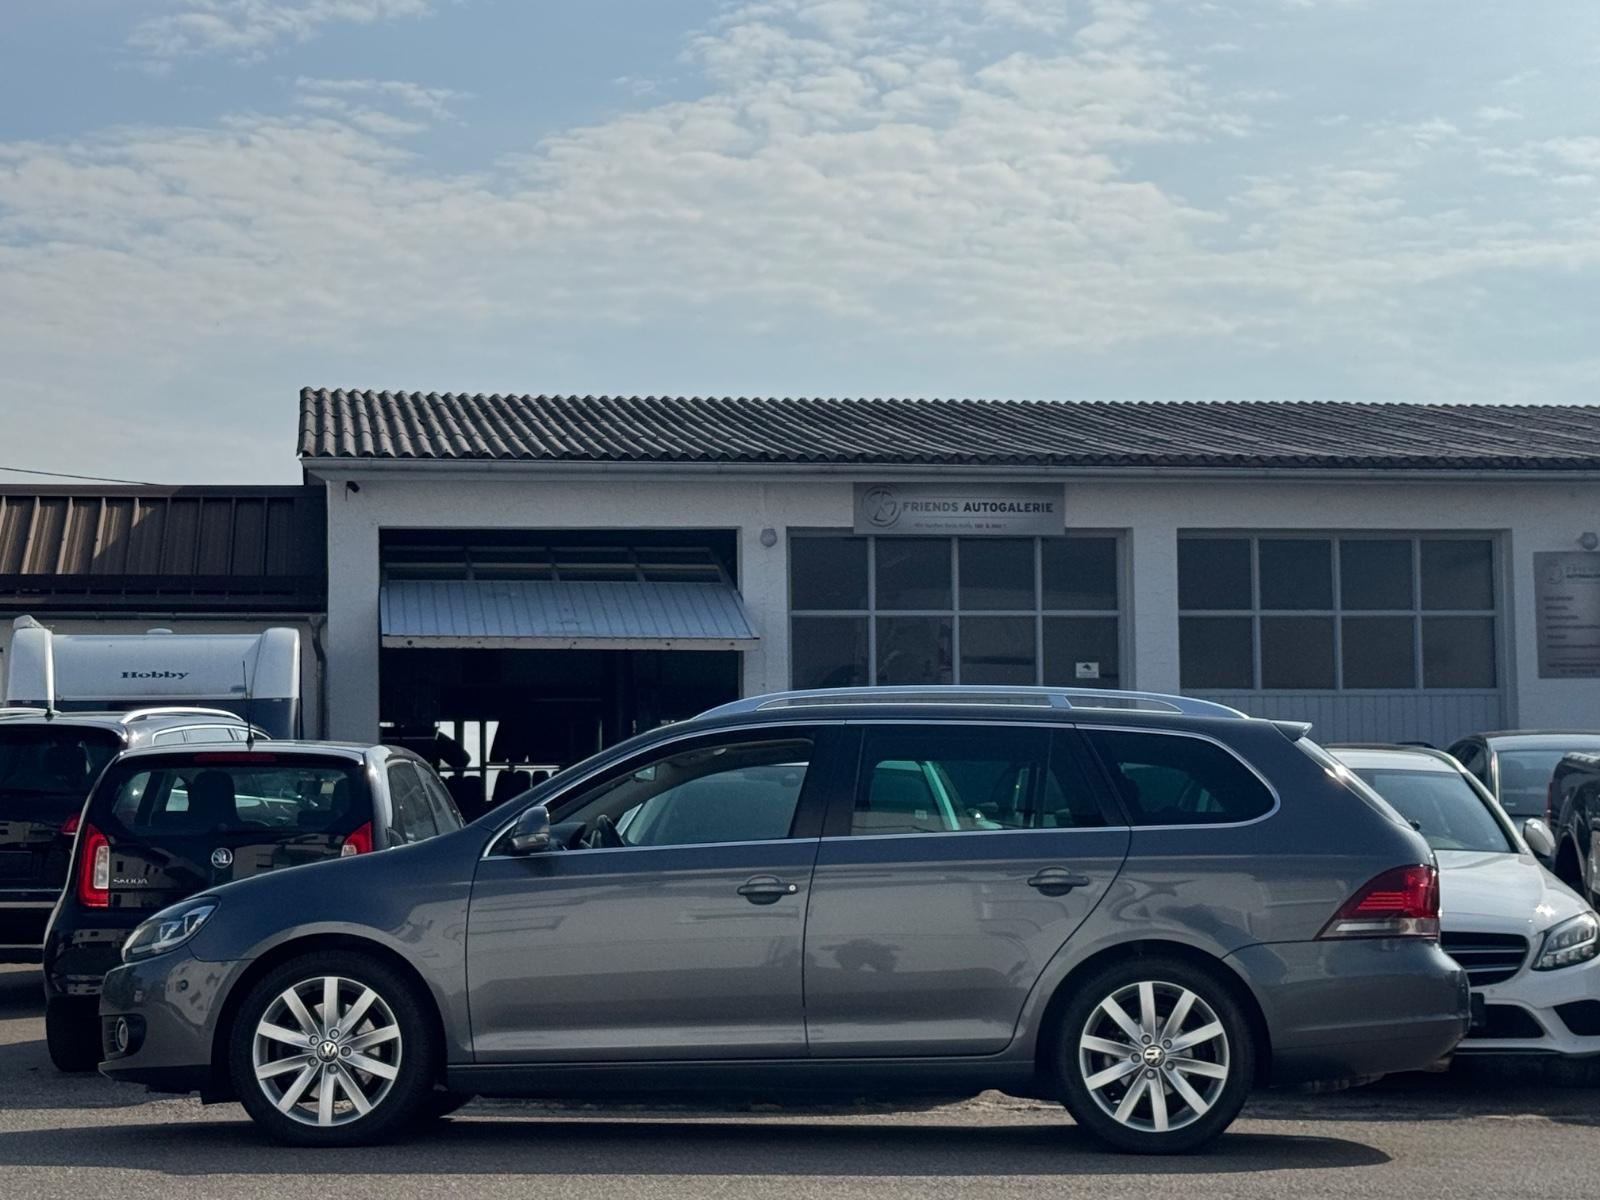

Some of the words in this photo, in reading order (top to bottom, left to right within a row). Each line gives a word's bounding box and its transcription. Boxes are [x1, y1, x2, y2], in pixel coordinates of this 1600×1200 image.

[902, 501, 959, 513] FRIENDS
[963, 501, 1054, 513] AUTOGALERIE
[121, 670, 190, 680] Hobby
